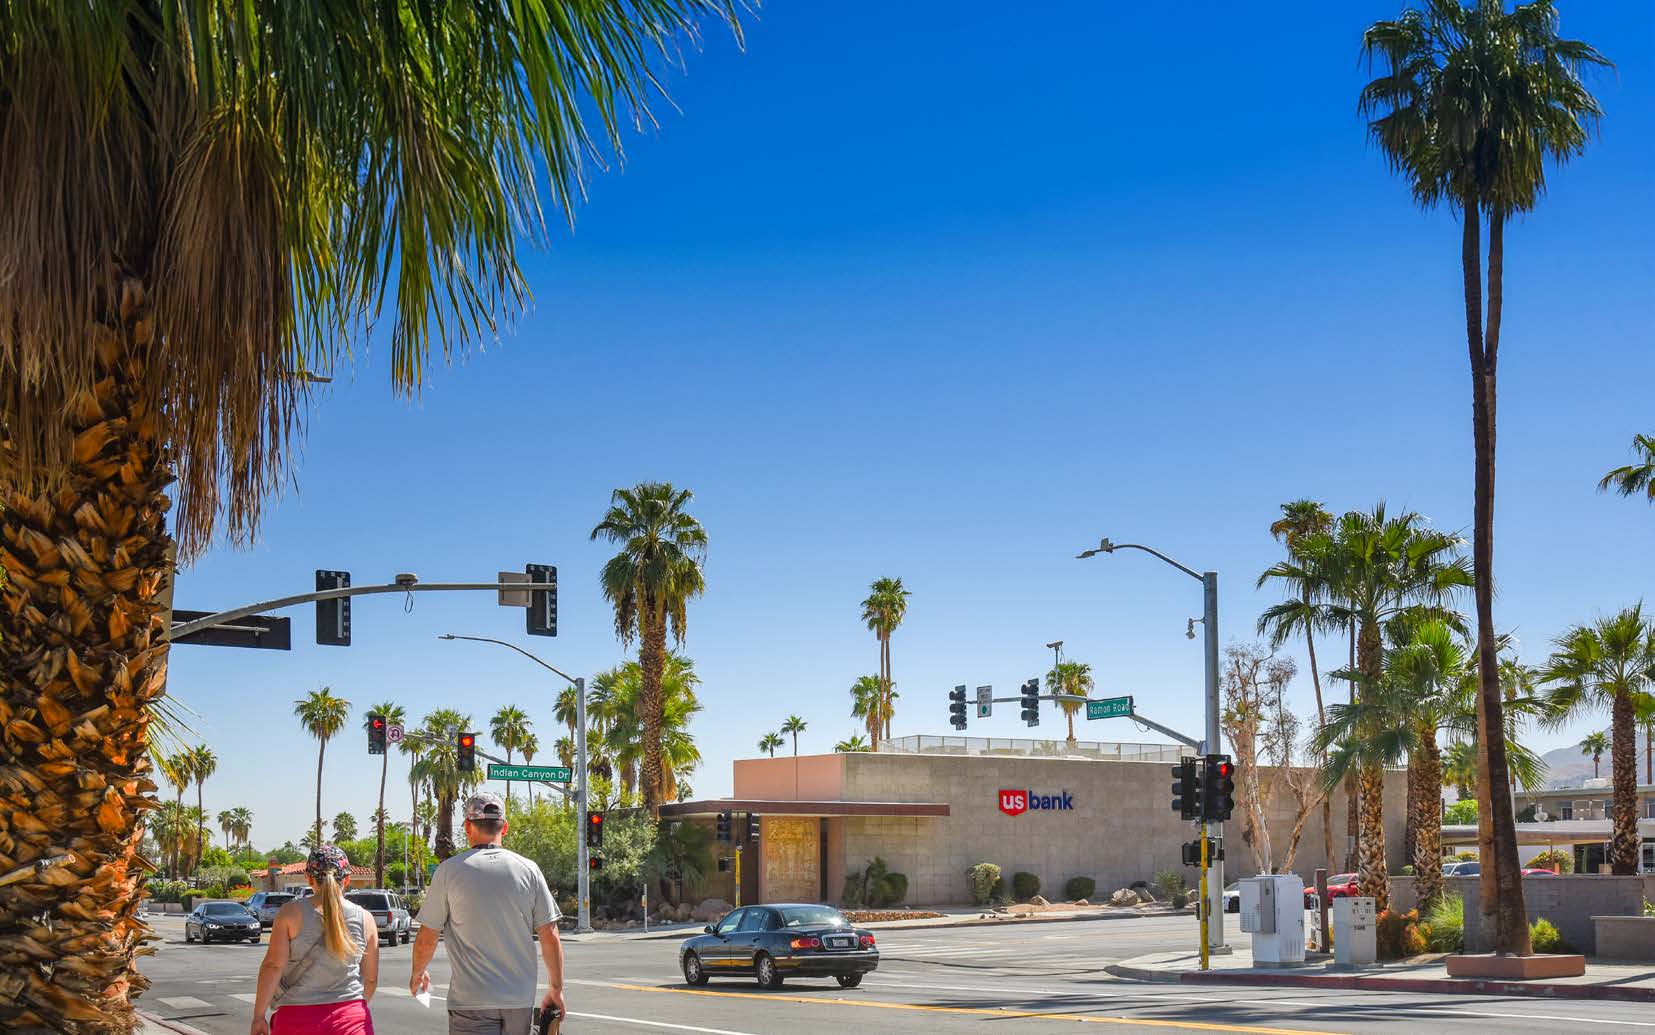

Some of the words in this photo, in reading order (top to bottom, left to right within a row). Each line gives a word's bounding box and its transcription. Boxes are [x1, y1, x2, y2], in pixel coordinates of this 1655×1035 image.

[1090, 705, 1111, 715] Ramon
[1113, 702, 1130, 713] Road
[490, 767, 519, 777] Indian
[521, 769, 556, 780] Canyon
[558, 771, 569, 779] Dr
[1002, 795, 1025, 810] us
[1028, 790, 1074, 810] bank
